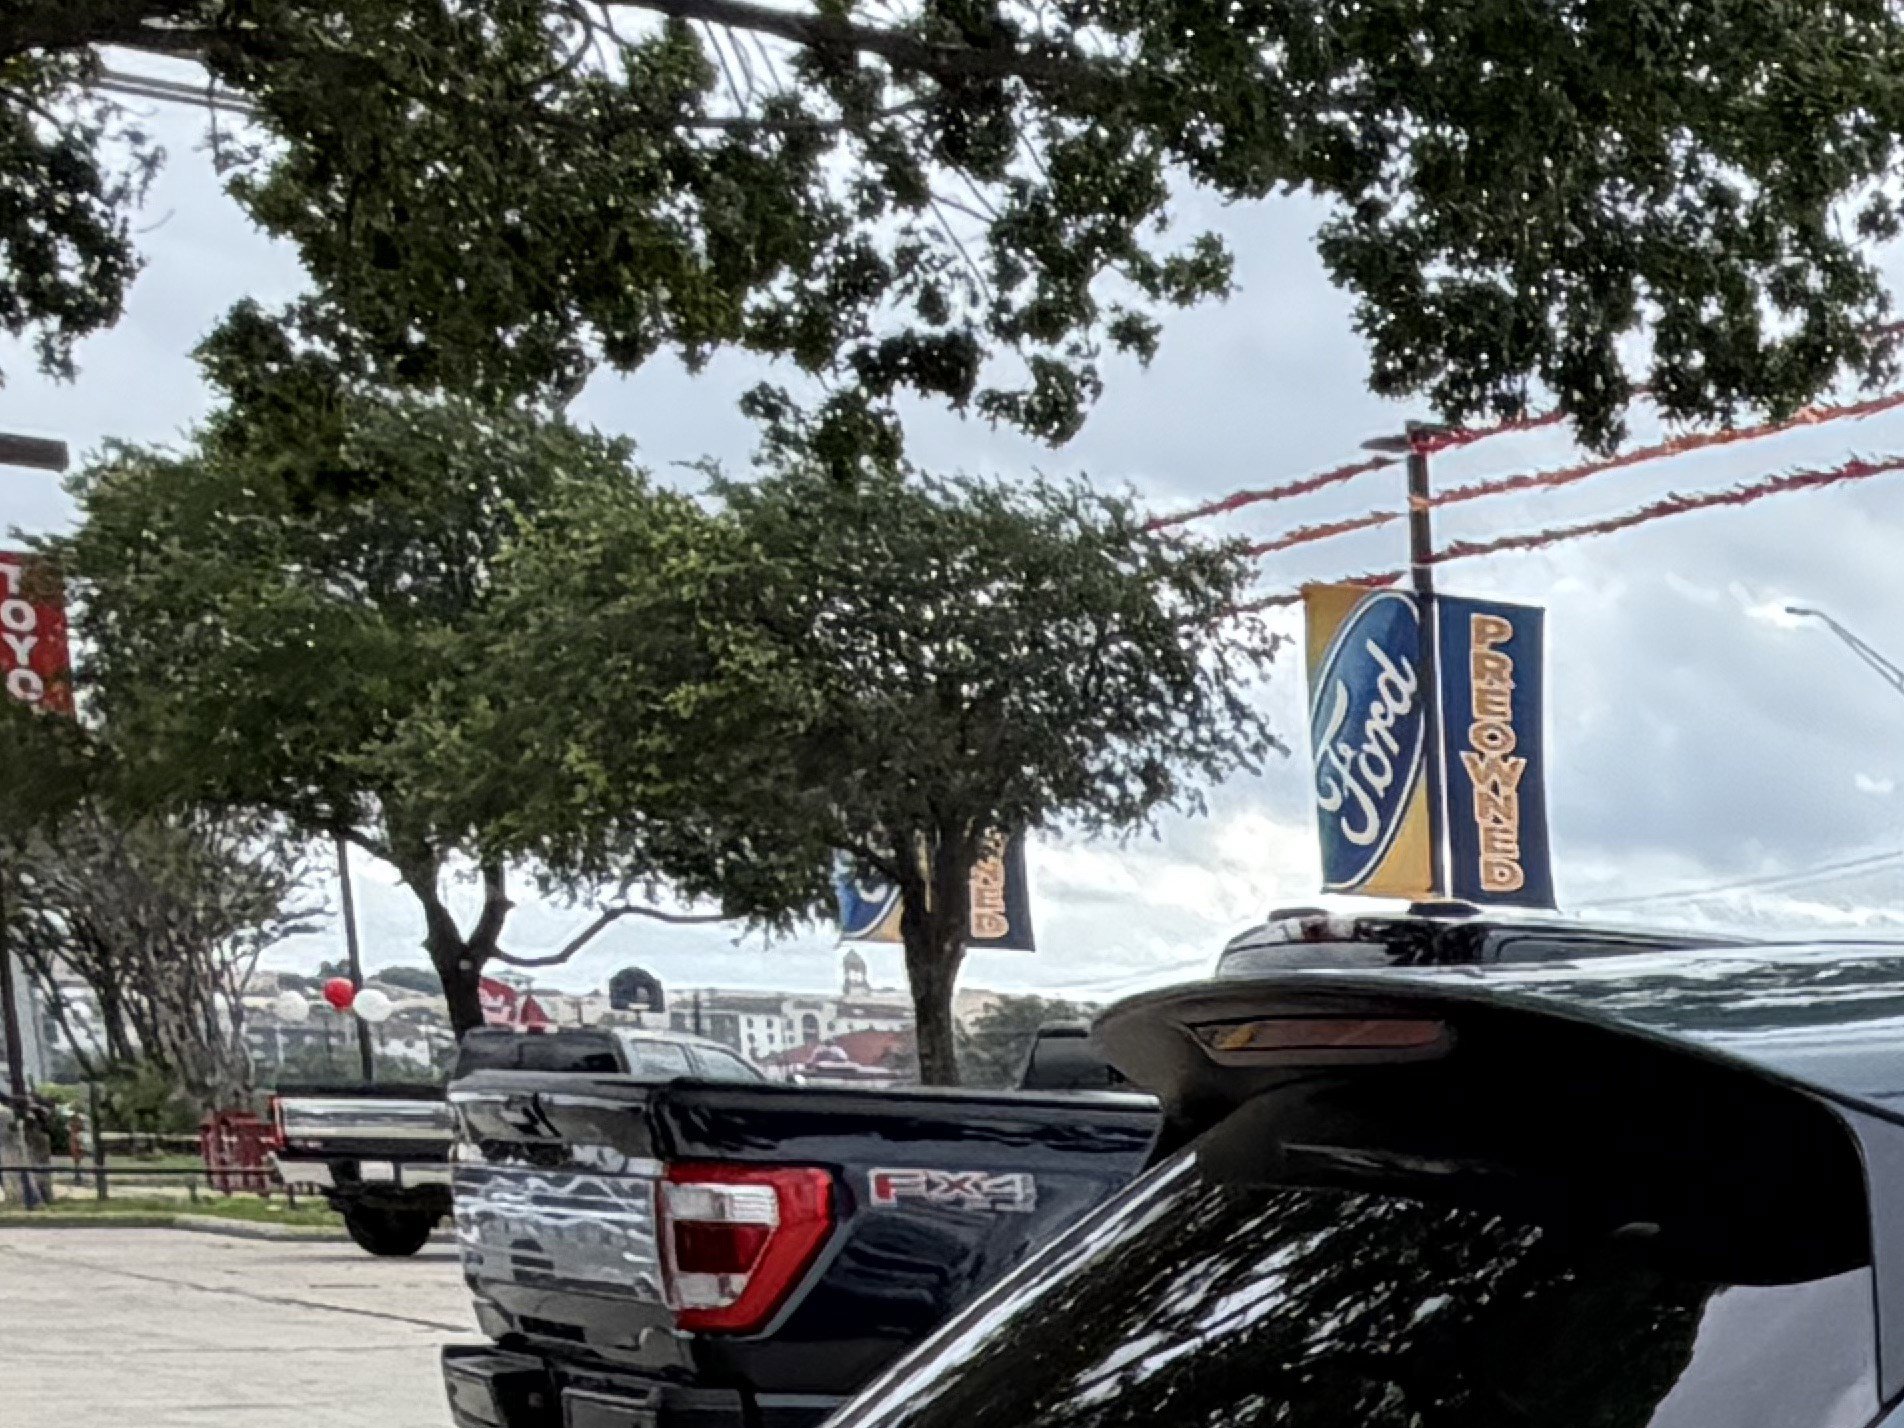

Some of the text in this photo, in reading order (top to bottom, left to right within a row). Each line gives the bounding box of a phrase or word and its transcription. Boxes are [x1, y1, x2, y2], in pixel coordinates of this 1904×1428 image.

[0, 563, 44, 712] TOYO
[1312, 639, 1418, 846] Ford
[1458, 612, 1528, 892] PREOWNED
[868, 1167, 1036, 1213] FX4
